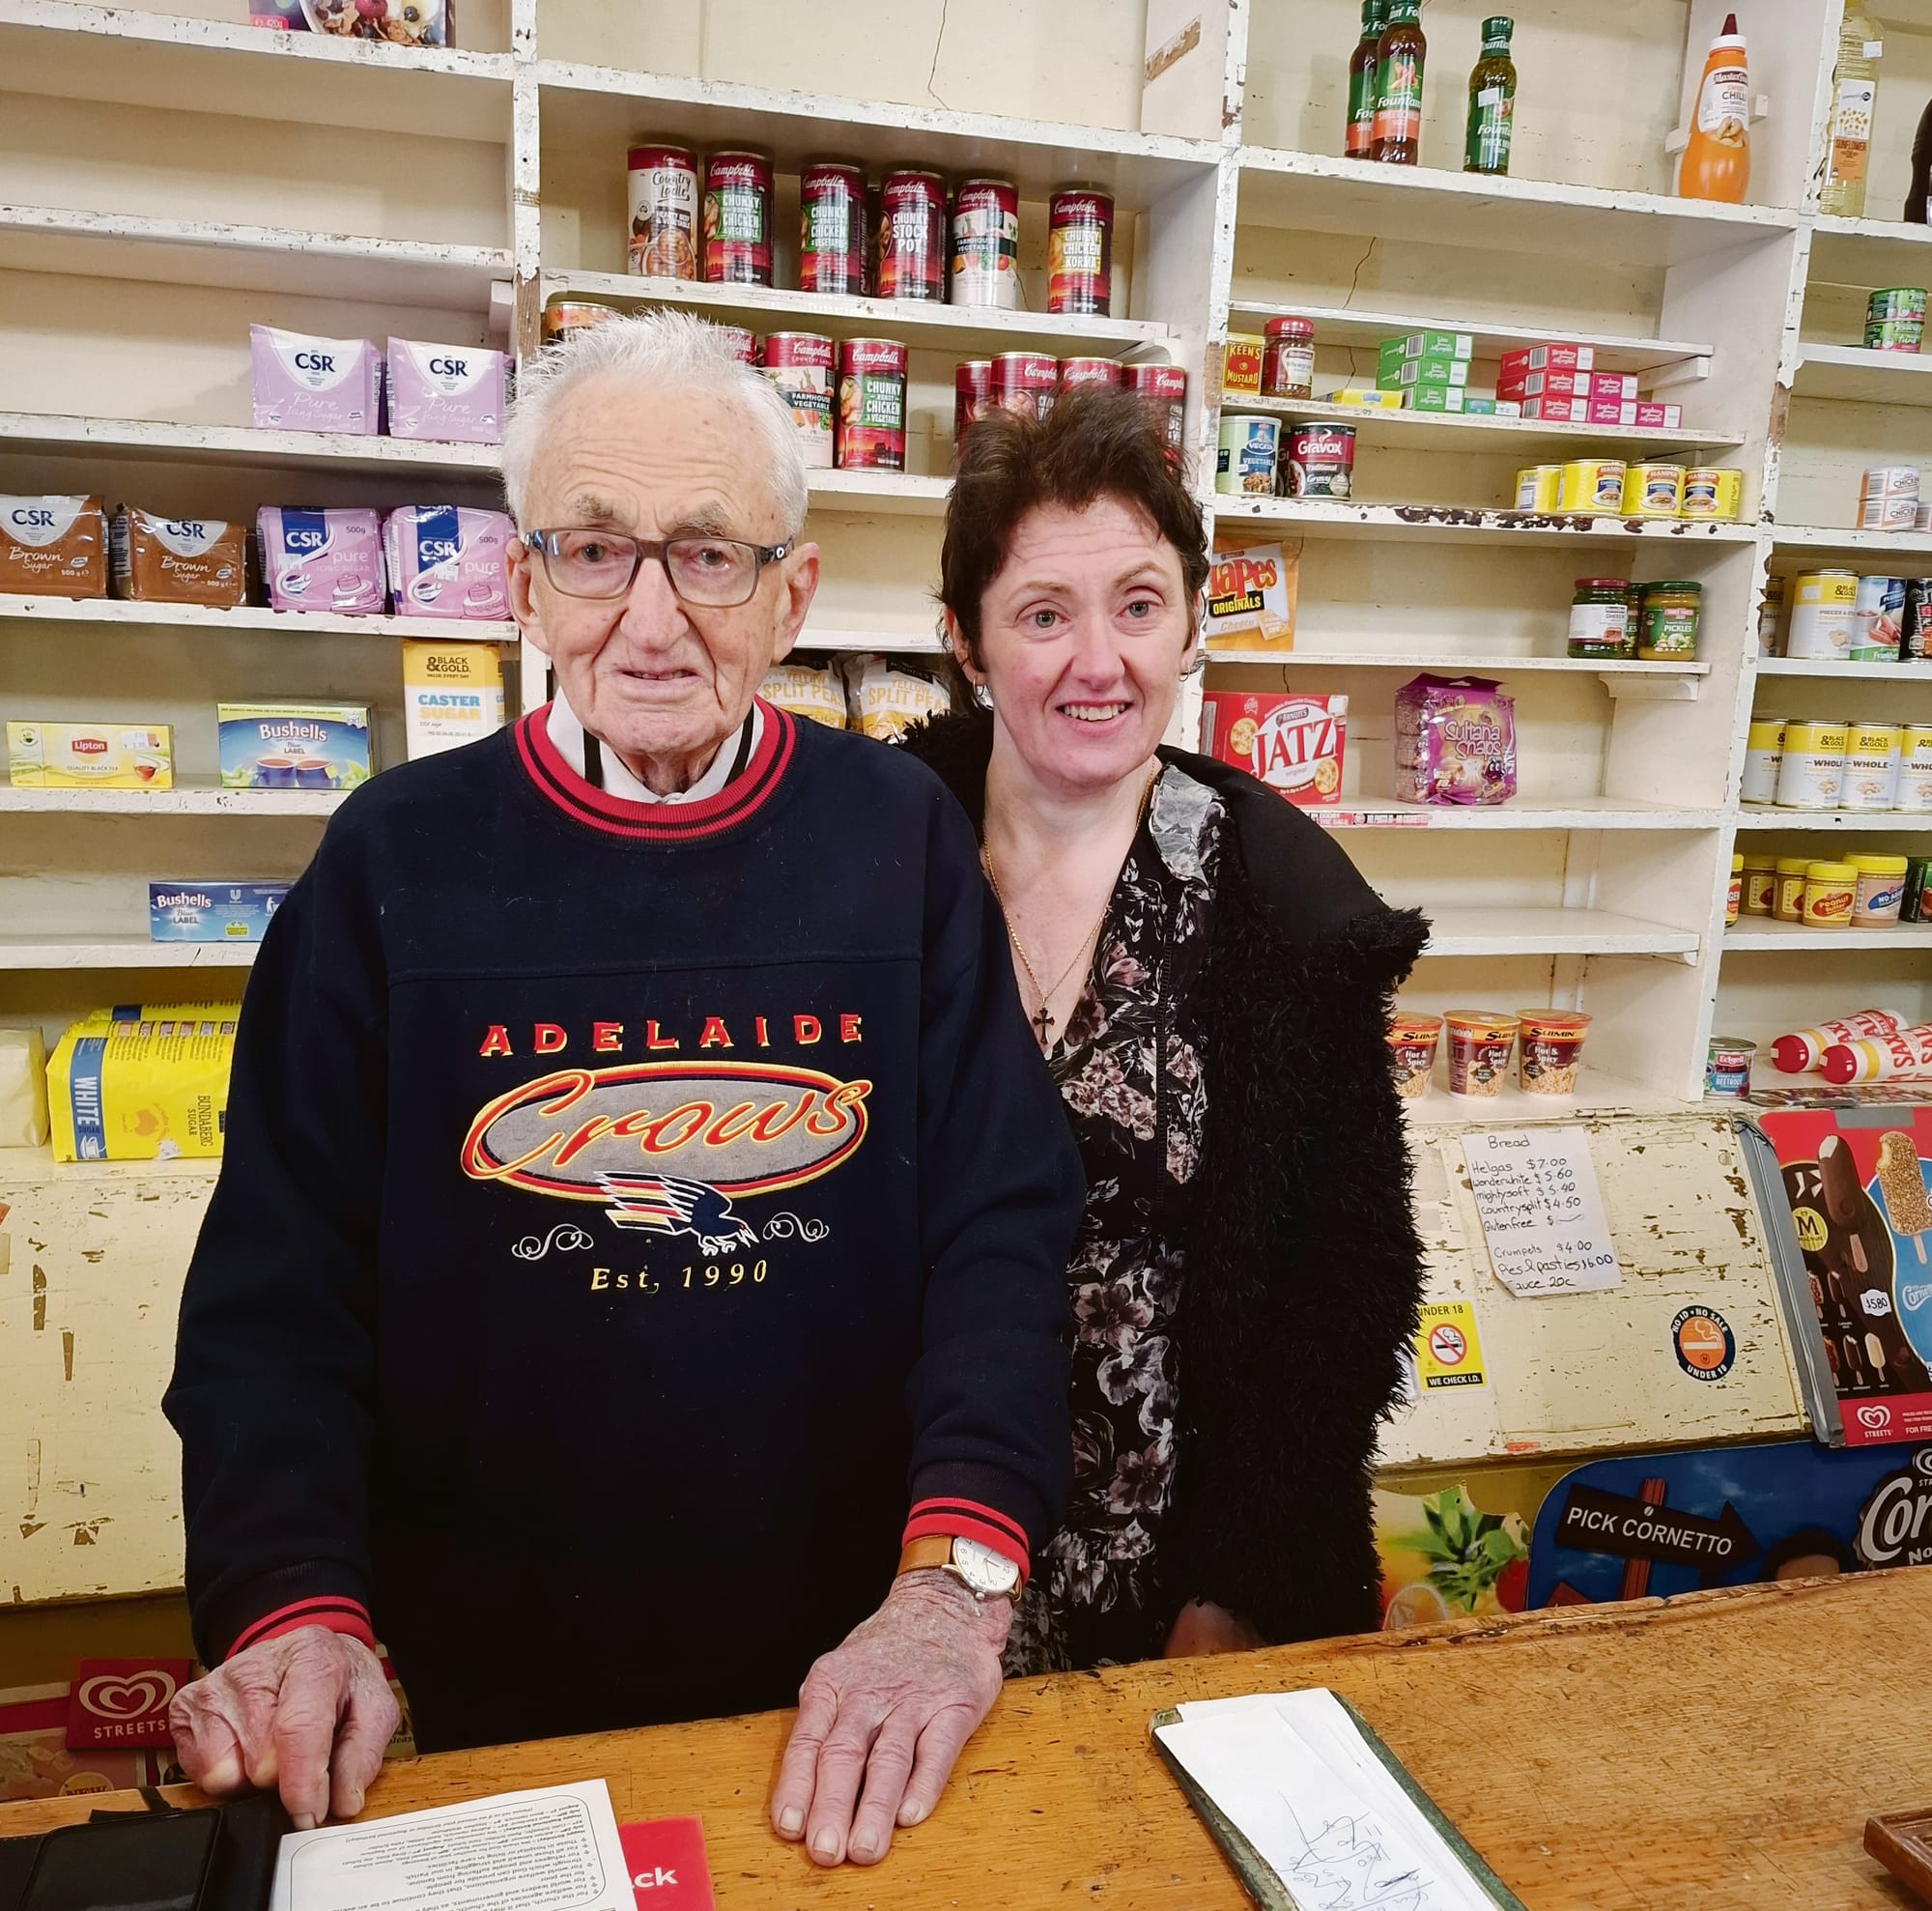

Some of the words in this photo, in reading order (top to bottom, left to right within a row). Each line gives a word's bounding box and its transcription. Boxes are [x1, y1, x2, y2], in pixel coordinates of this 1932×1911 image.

[710, 161, 754, 178] Campbell's
[652, 172, 691, 190] Country
[723, 194, 759, 209] CHUNKY
[1055, 199, 1097, 215] Campbell's
[723, 213, 759, 227] CHICKEN
[893, 212, 928, 225] CHUNKY
[810, 225, 847, 238] CHICKEN
[893, 224, 927, 240] STOCK
[897, 239, 922, 253] POT
[1064, 242, 1101, 256] CHICKEN
[1065, 255, 1096, 269] KORMA
[793, 341, 832, 359] Campbell's
[852, 347, 900, 365] Campbell's
[1229, 344, 1261, 360] KEEN'S
[294, 353, 331, 372] CSR
[429, 358, 468, 377] CSR
[1227, 371, 1259, 385] MUSTARD
[867, 382, 901, 396] CHUNKY
[294, 391, 339, 412] Pure
[792, 392, 831, 404] FARMHOUSE
[793, 400, 831, 411] VEGETABLE
[429, 398, 472, 414] Pure
[867, 400, 900, 416] CHICKEN
[313, 409, 344, 423] Sugar
[871, 414, 899, 425] VEGETABLE
[1249, 442, 1273, 452] VEGETA
[1297, 440, 1342, 455] Gravox
[1306, 463, 1338, 472] Traditional
[1307, 473, 1330, 484] Gravy
[12, 509, 55, 528] CSR
[166, 520, 206, 539] CSR
[346, 526, 366, 535] 500g
[286, 531, 325, 548] CSR
[478, 536, 498, 545] 500g
[9, 546, 65, 563] Brown
[419, 540, 457, 557] CSR
[160, 556, 212, 574] Brown
[332, 551, 368, 565] pure
[22, 561, 53, 574] Sugar
[465, 560, 500, 575] pure
[173, 570, 200, 582] Sugar
[1212, 596, 1262, 616] ORIGINALS
[1663, 624, 1692, 633] PICKLES
[426, 656, 440, 672] &
[787, 667, 825, 685] YELLOW
[892, 674, 931, 696] YELLOW
[417, 695, 480, 706] CASTER
[763, 683, 804, 700] SPLIT
[810, 683, 844, 707] PEAS
[868, 686, 909, 706] SPLIT
[419, 706, 480, 721] SUGAR
[259, 720, 327, 743] Bushells
[1444, 720, 1501, 742] Sultana
[74, 740, 105, 752] Lipton
[283, 747, 306, 756] LABEL
[1250, 717, 1337, 783] JATZ
[1455, 739, 1502, 761] Snaps
[1853, 759, 1889, 770] WHOLE
[156, 892, 212, 909] Bushells
[1819, 895, 1849, 908] Peanut
[1878, 895, 1891, 903] NO
[173, 916, 199, 925] LABEL
[478, 1013, 864, 1057] ADELAIDE
[1405, 1049, 1419, 1059] Hot
[1420, 1050, 1428, 1059] &
[1489, 1049, 1501, 1058] Hot
[1500, 1050, 1508, 1059] &
[1534, 1045, 1549, 1056] Hot
[1549, 1045, 1559, 1056] &
[1406, 1057, 1427, 1069] Spicy
[1490, 1057, 1507, 1068] Spicy
[1537, 1054, 1558, 1065] Spicy
[1719, 1054, 1745, 1065] Edgell
[74, 1076, 100, 1126] WHITE
[186, 1108, 198, 1136] SUGAR
[197, 1095, 214, 1148] BUNDABERG
[461, 1069, 873, 1181] Crows
[1488, 1134, 1532, 1150] Bread
[1472, 1160, 1514, 1177] Helgas
[1526, 1157, 1568, 1171] $7.00
[1797, 1215, 1820, 1237] M
[1493, 1243, 1544, 1259] Crumpets
[1556, 1240, 1593, 1255] $4.00
[682, 1259, 769, 1289] 1990
[1548, 1276, 1577, 1288] 20c
[1453, 1304, 1463, 1315] 18
[1671, 1321, 1682, 1333] NO
[1681, 1310, 1690, 1322] ID
[1695, 1307, 1708, 1317] NO
[1710, 1313, 1729, 1333] SALE
[1687, 1364, 1718, 1380] UNDER
[1718, 1363, 1727, 1376] 18
[1429, 1377, 1442, 1386] WE
[1443, 1376, 1468, 1384] CHECK
[1864, 1430, 1891, 1439] STREETS
[1905, 1426, 1919, 1435] FOR
[1566, 1506, 1617, 1534] PICK
[1621, 1518, 1734, 1557] CORNETTO
[94, 1719, 167, 1740] STREETS
